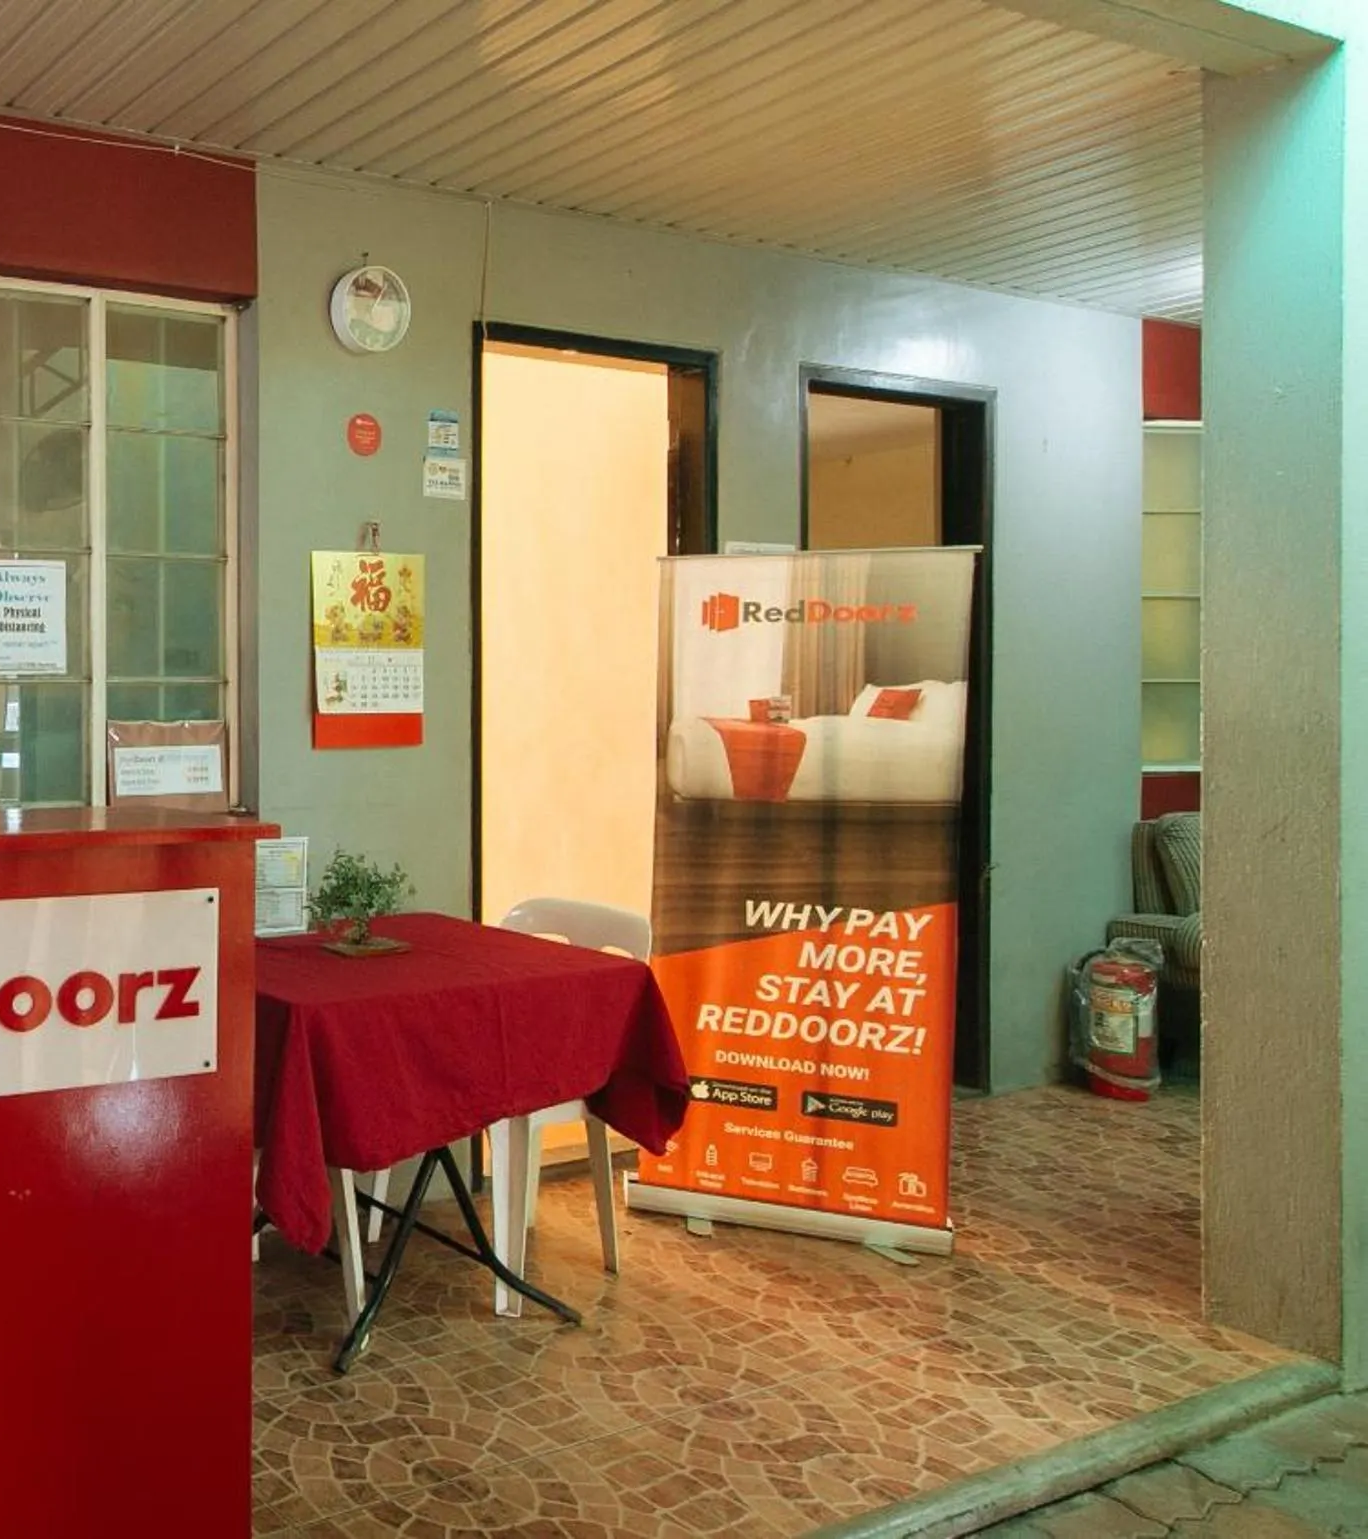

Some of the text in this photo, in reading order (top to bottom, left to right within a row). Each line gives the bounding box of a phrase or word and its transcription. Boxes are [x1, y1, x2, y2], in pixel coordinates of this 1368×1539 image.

[350, 560, 392, 613] 福
[4, 607, 41, 618] Physical
[742, 598, 917, 624] RedDoorz
[0, 621, 46, 633] Distancing
[745, 900, 932, 941] WHY PAY
[798, 941, 927, 985] MORE,
[755, 974, 926, 1016] STAY AT
[696, 1003, 927, 1055] REDDOORZ!
[715, 1049, 870, 1080] DOWNLOAD NOW!
[712, 1088, 773, 1106] App Store
[829, 1102, 868, 1118] Google
[871, 1110, 894, 1122] play
[724, 1122, 855, 1150] Services Guarantee
